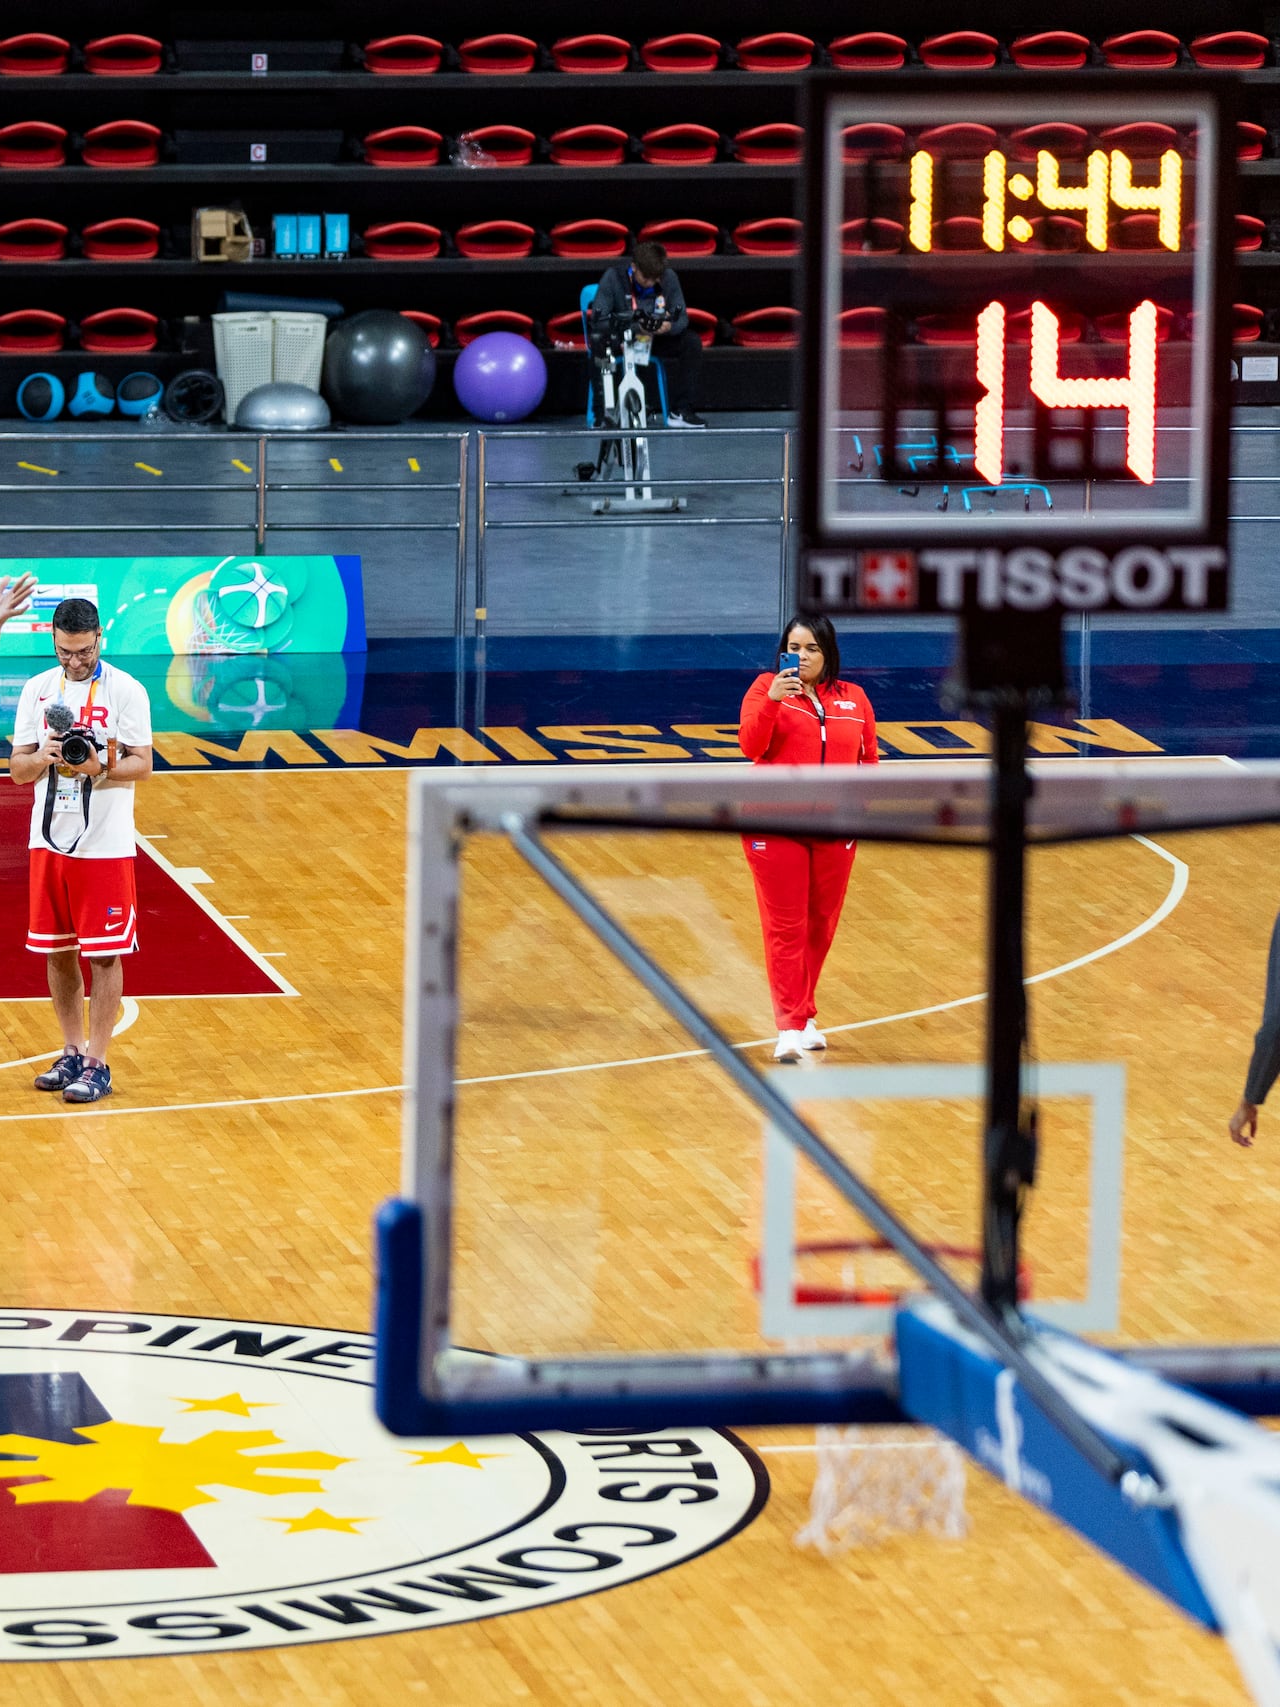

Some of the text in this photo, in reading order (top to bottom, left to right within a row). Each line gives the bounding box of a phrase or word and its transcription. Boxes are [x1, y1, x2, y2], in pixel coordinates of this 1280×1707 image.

[255, 55, 265, 69] D
[253, 145, 263, 160] C
[908, 149, 1183, 253] 11:44
[974, 299, 1158, 486] 14
[921, 545, 1227, 609] TISSOT
[568, 1427, 719, 1505] RTS
